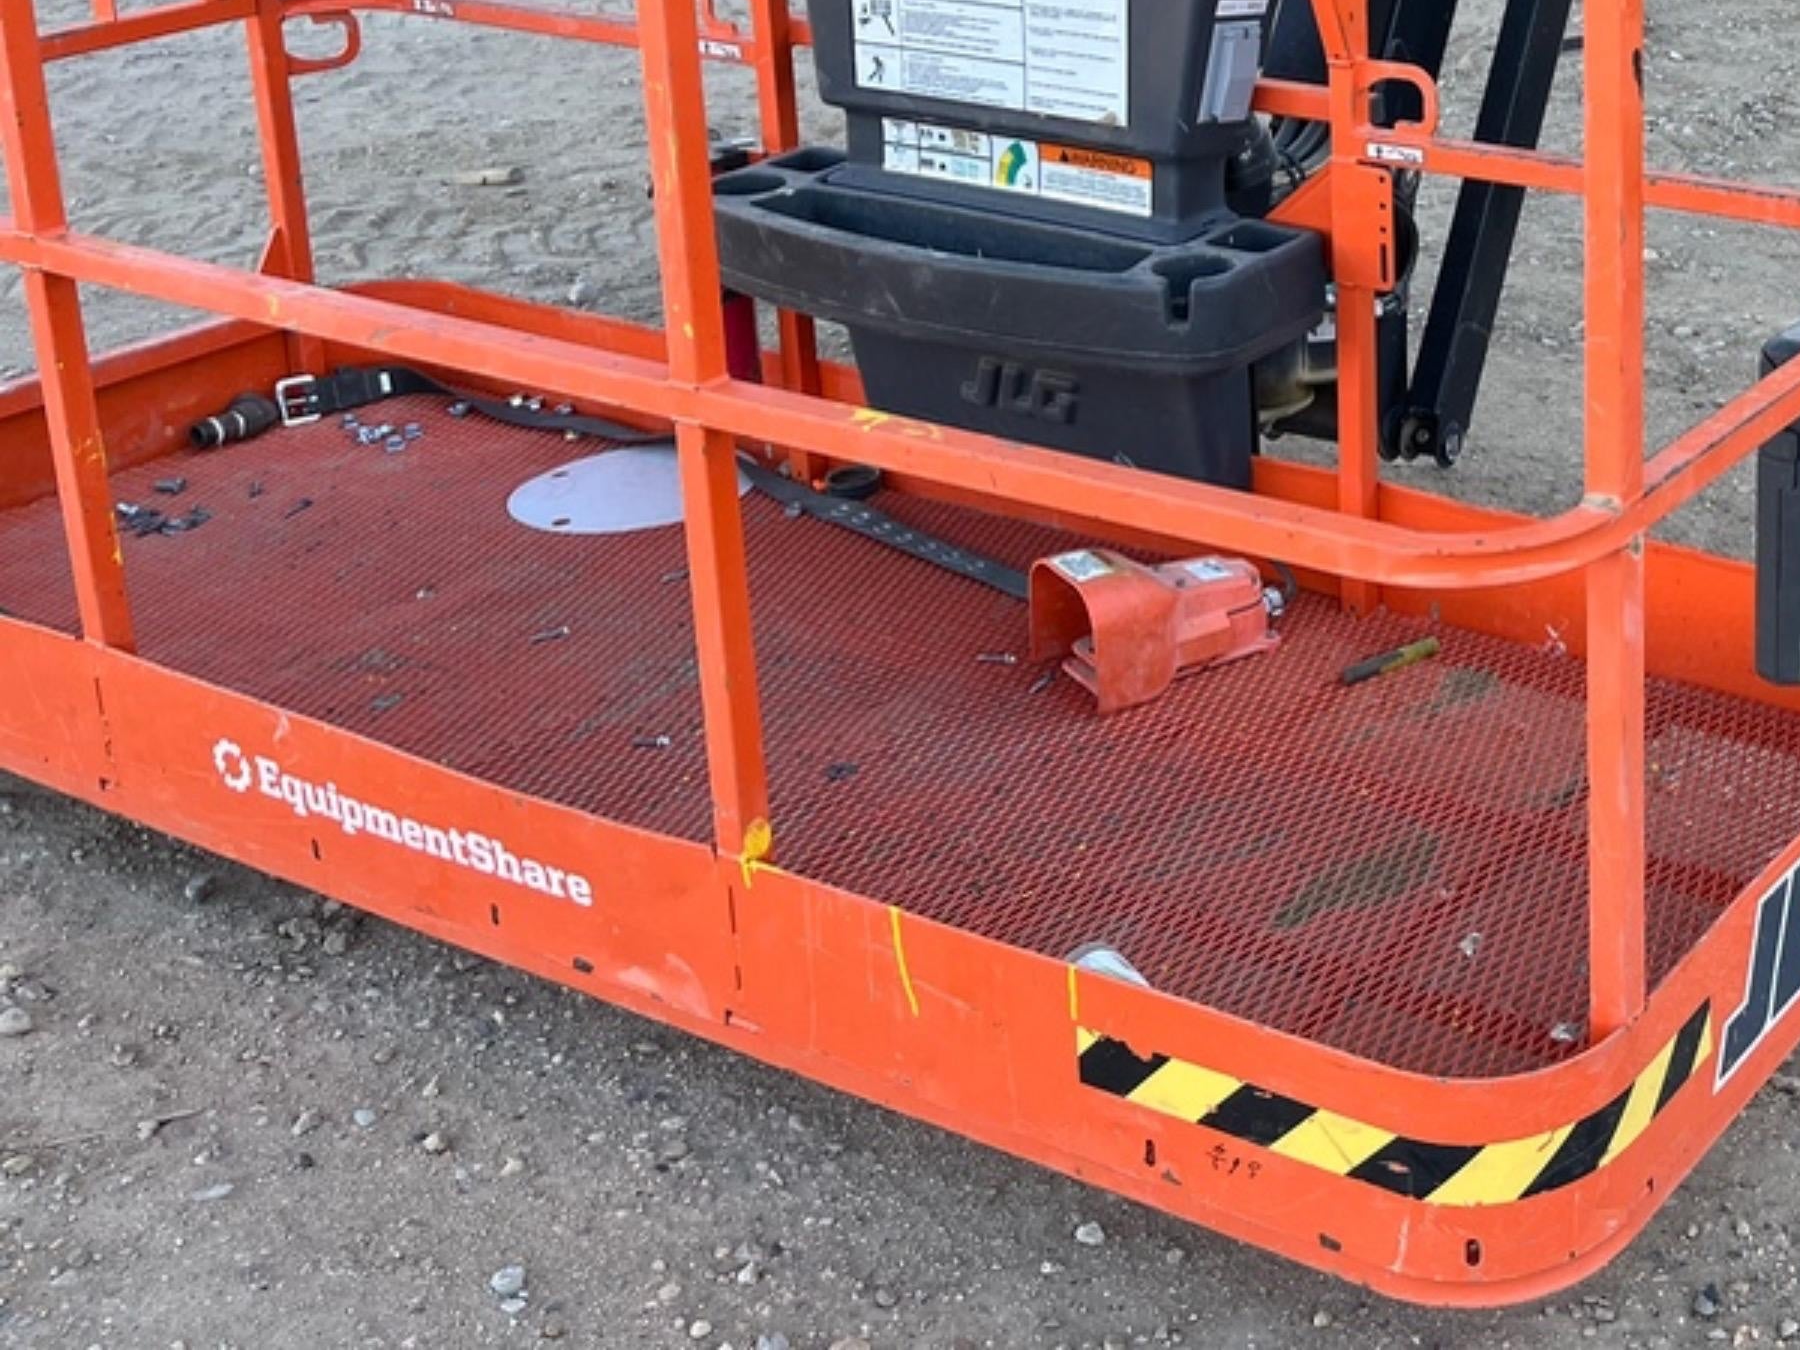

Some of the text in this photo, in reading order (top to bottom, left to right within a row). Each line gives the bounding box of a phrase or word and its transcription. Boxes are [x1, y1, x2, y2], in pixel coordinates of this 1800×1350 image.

[1072, 152, 1137, 175] WARNING
[959, 356, 1079, 425] JLG
[255, 755, 593, 907] EquipmentShare
